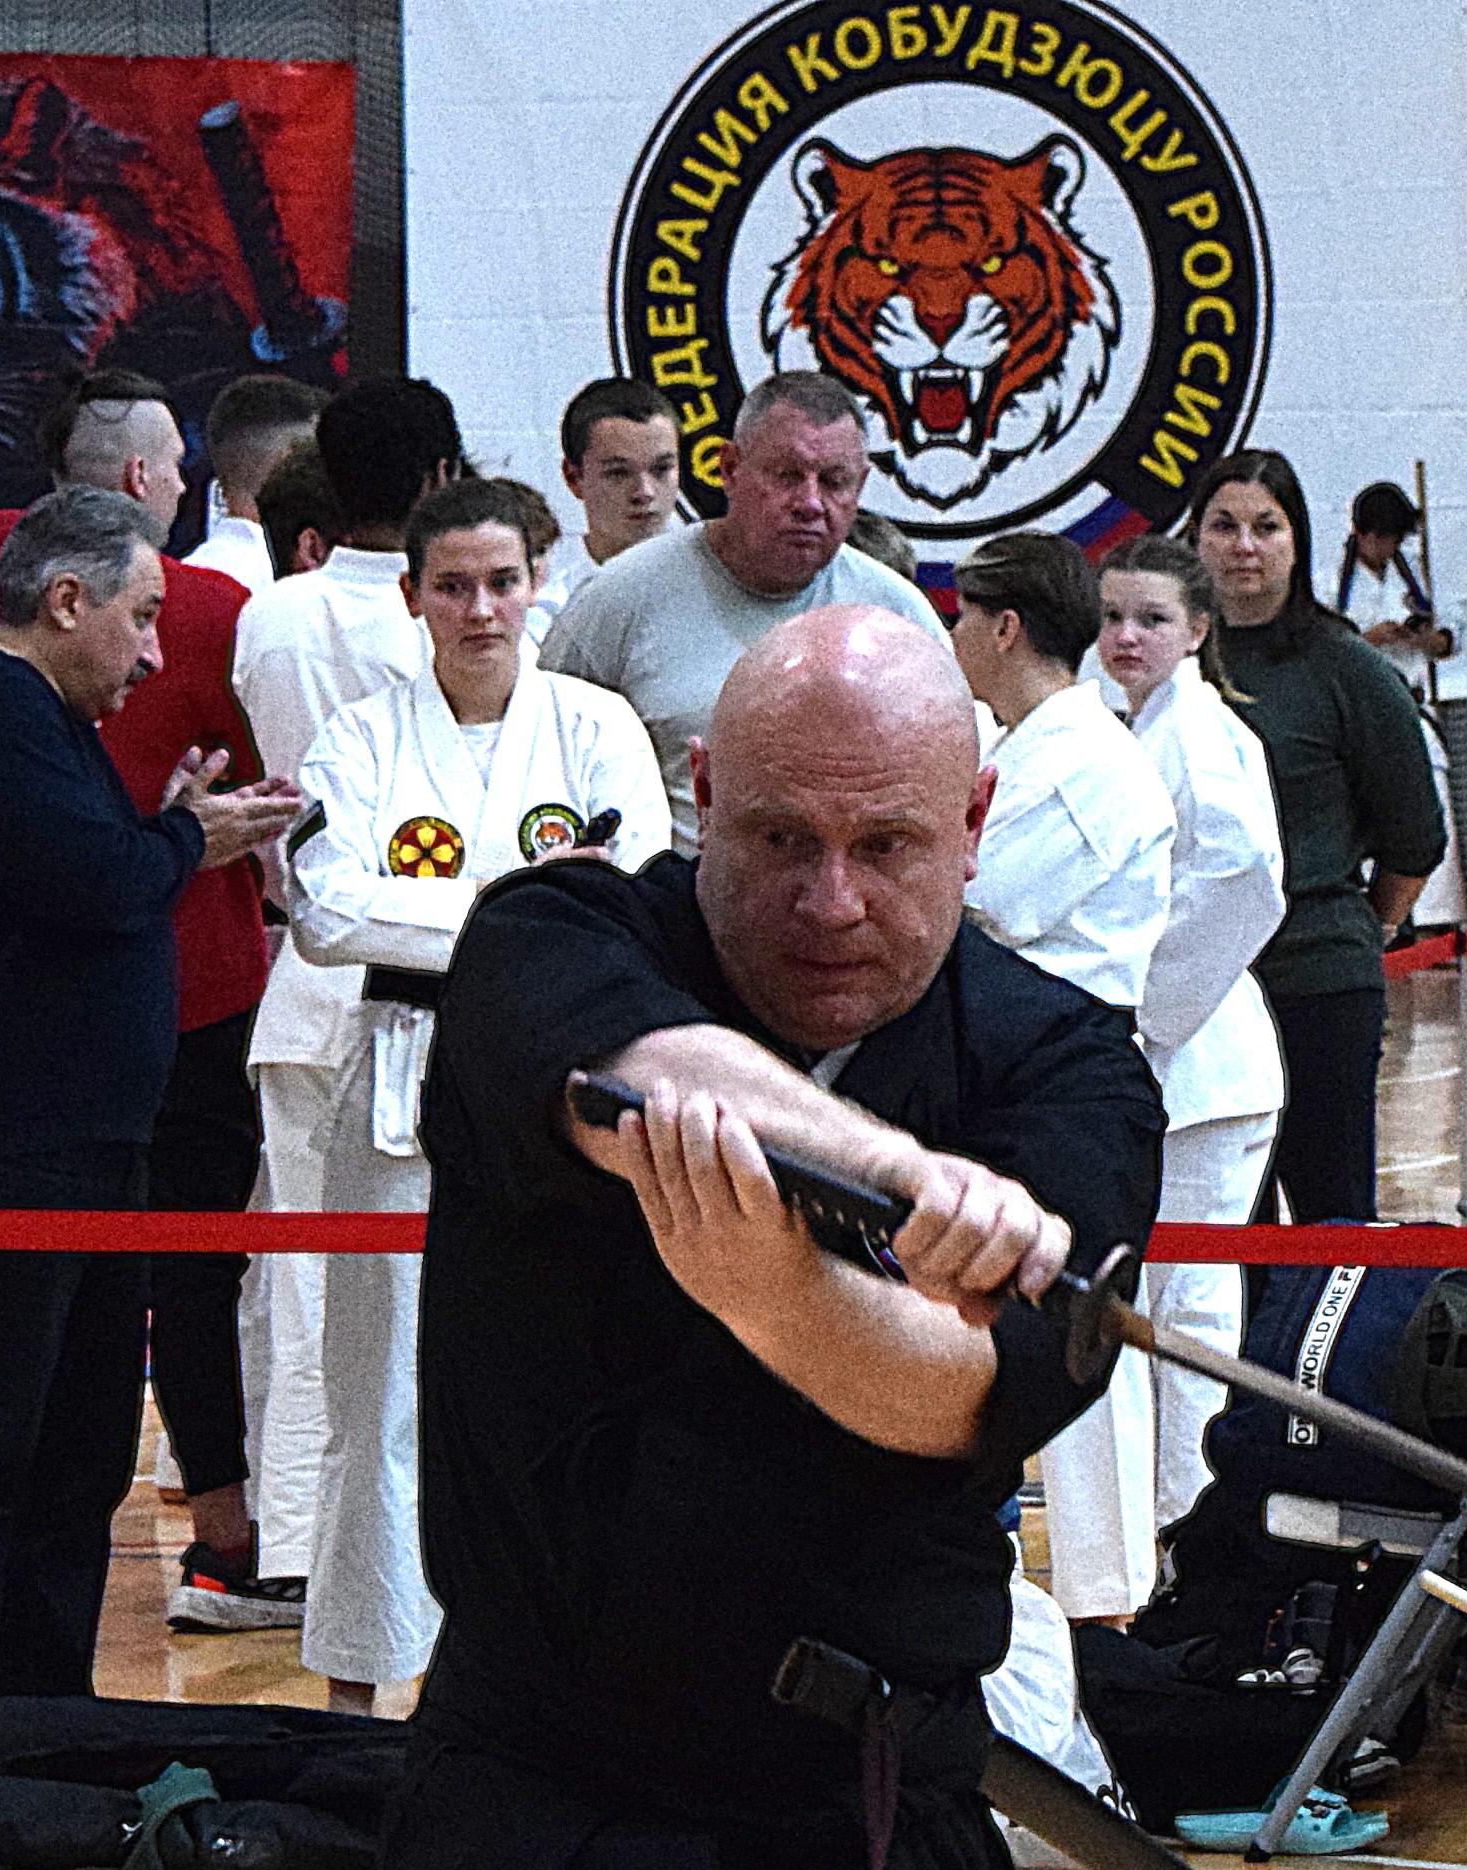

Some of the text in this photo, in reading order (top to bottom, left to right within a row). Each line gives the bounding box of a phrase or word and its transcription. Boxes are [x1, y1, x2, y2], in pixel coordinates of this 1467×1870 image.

[786, 4, 1200, 173] КОБУДЗЮЦУ
[1139, 190, 1237, 489] РОССИИ
[1301, 1321, 1330, 1390] WORLD
[1322, 1286, 1349, 1318] ONE
